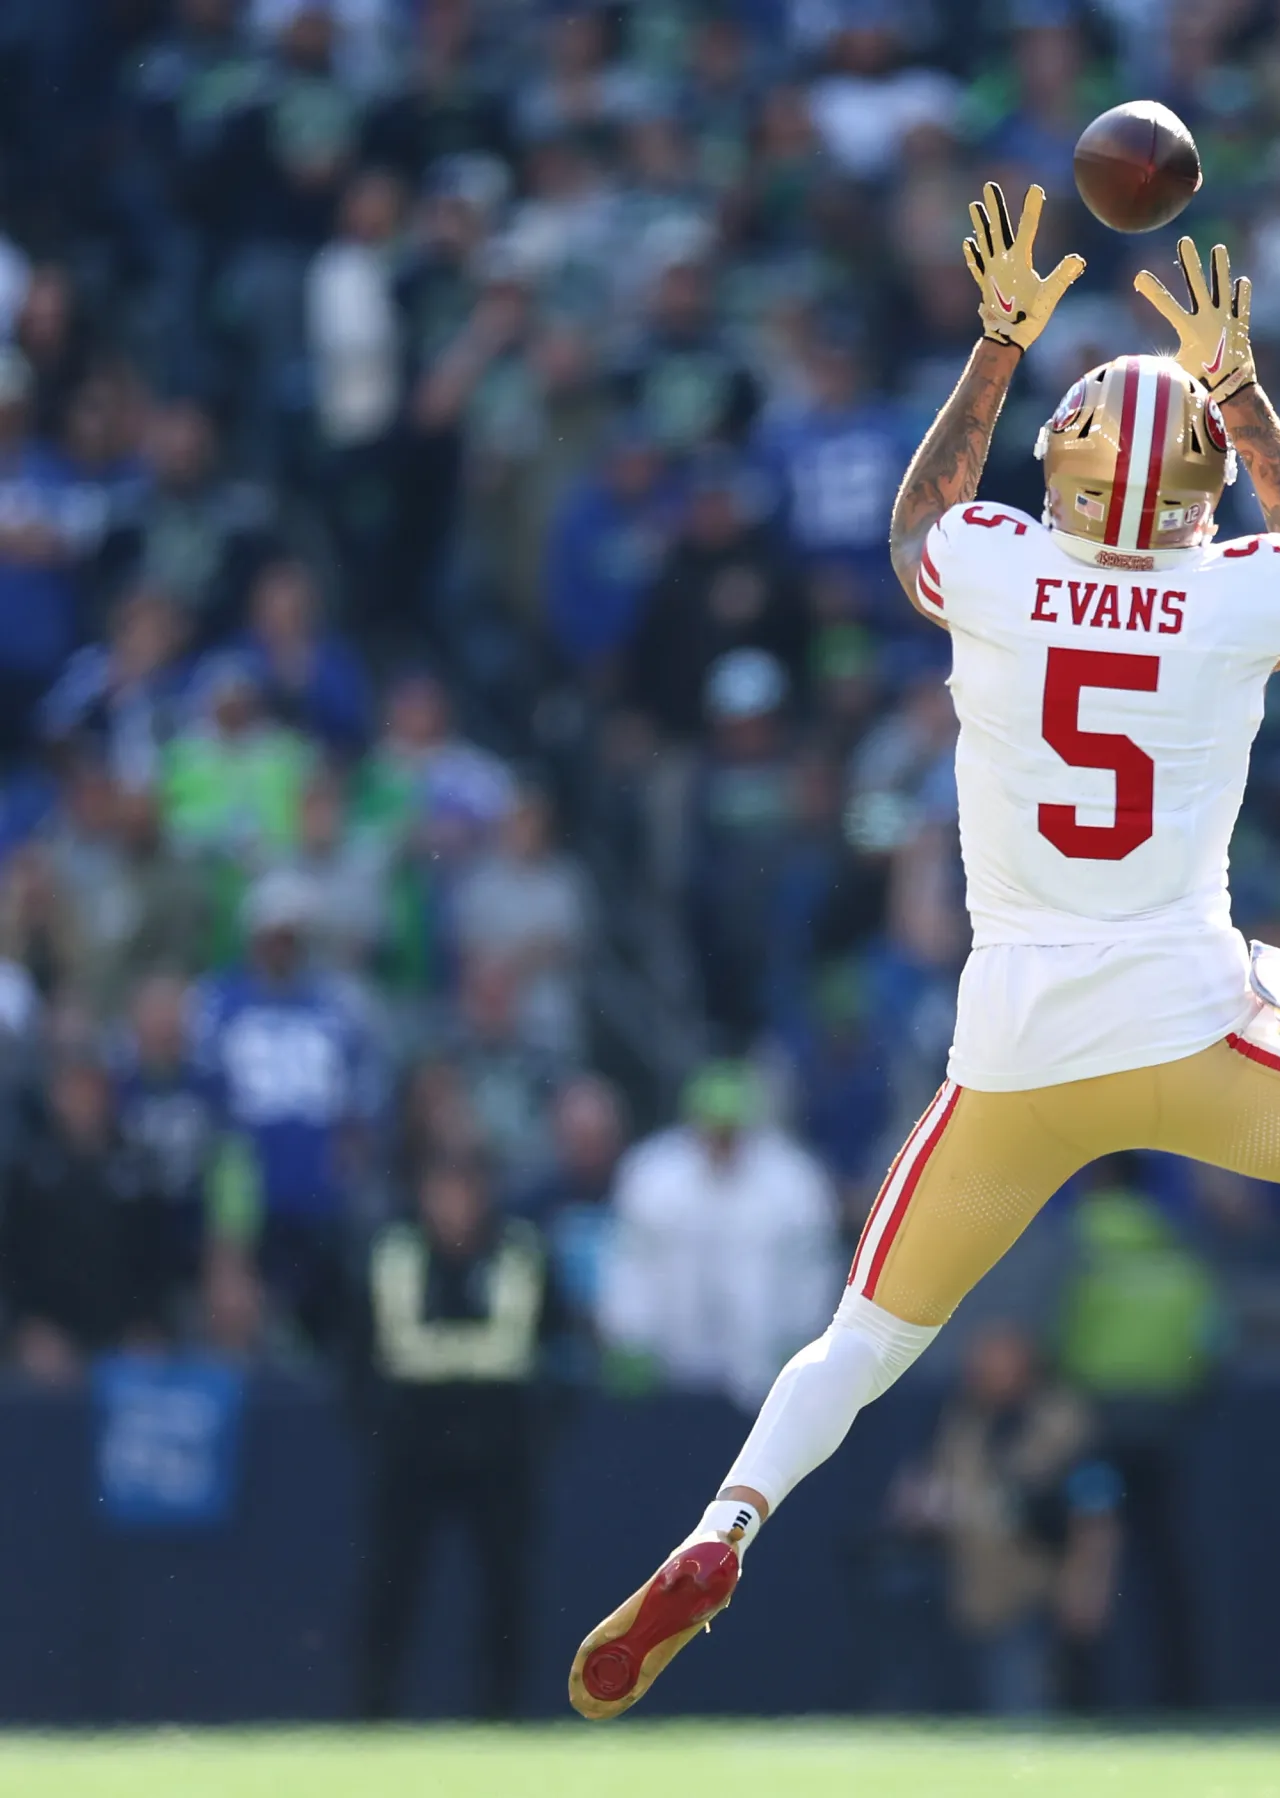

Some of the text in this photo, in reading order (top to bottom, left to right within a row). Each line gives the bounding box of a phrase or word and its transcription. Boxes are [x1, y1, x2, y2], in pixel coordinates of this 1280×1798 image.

[963, 507, 1027, 535] 5
[1031, 578, 1186, 634] EVANS
[1038, 646, 1160, 861] 5
